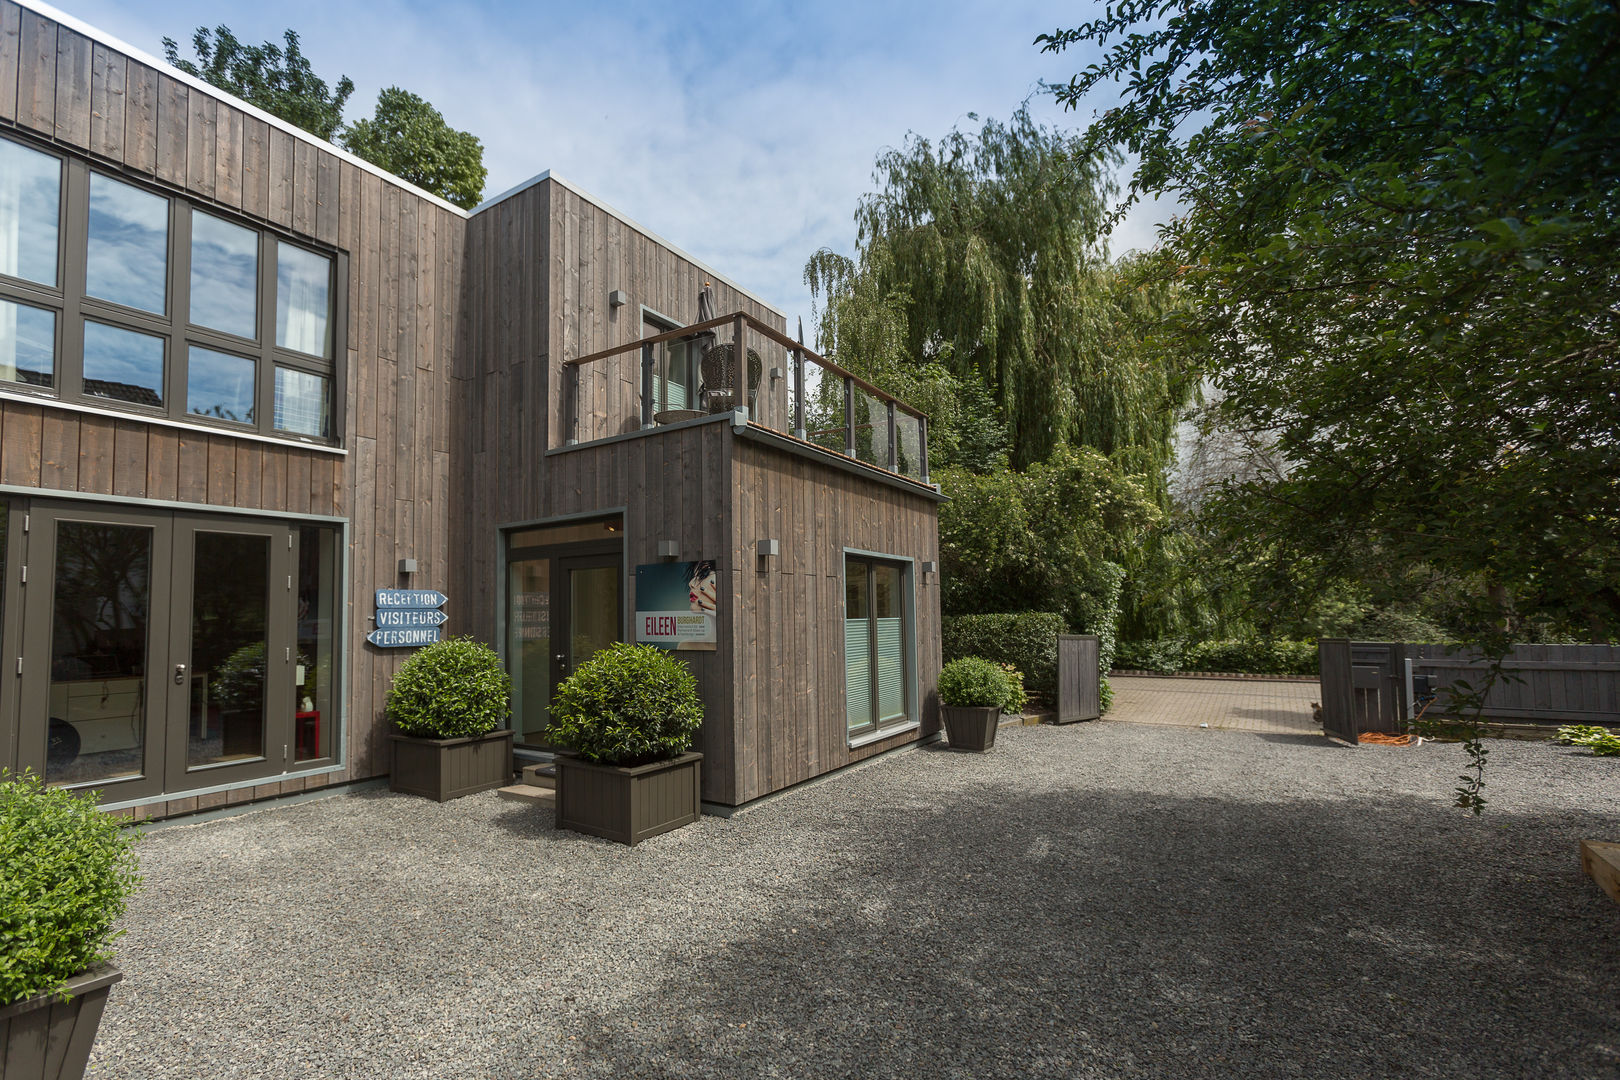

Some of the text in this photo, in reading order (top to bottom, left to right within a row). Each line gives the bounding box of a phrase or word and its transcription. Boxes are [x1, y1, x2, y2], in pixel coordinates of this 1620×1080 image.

[379, 592, 437, 605] RECEPTION
[380, 611, 441, 625] VISITEURS
[645, 616, 677, 636] EILEEN
[376, 630, 439, 645] PERSONNEL
